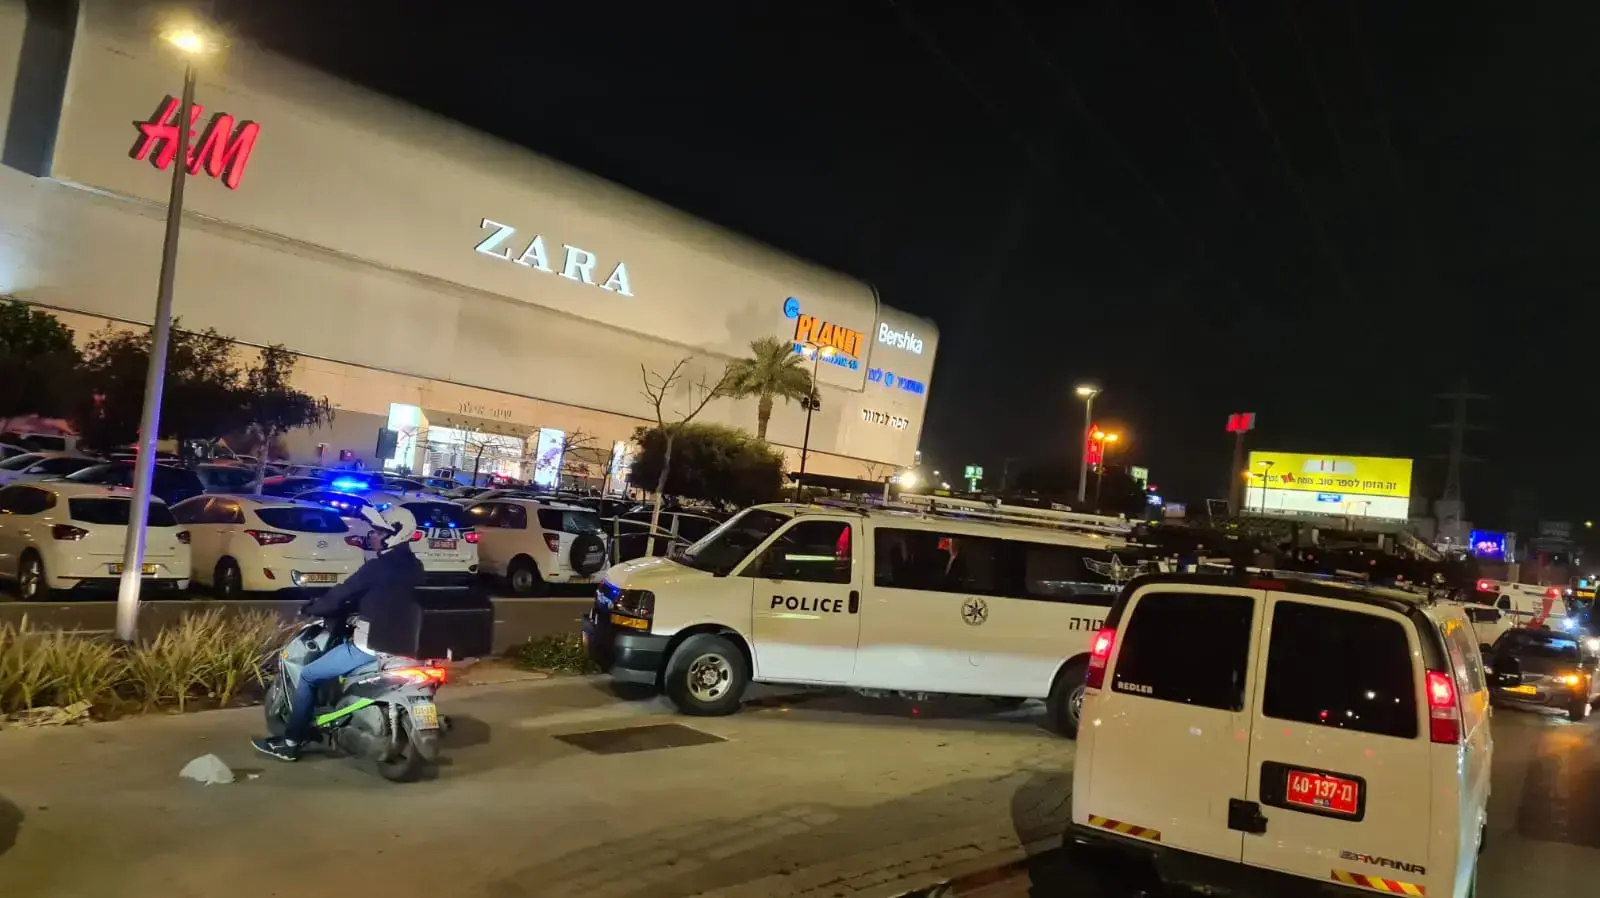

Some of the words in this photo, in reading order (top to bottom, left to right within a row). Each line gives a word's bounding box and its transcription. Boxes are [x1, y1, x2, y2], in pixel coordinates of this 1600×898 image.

[473, 217, 635, 297] ZARA
[794, 313, 864, 359] PLANET
[880, 323, 923, 354] Bershka
[863, 408, 890, 426] לנדוור
[891, 416, 908, 430] קפה
[1336, 477, 1360, 488] לספר
[1363, 480, 1384, 490] הזמן
[1386, 482, 1397, 490] זה
[771, 595, 844, 613] POLICE
